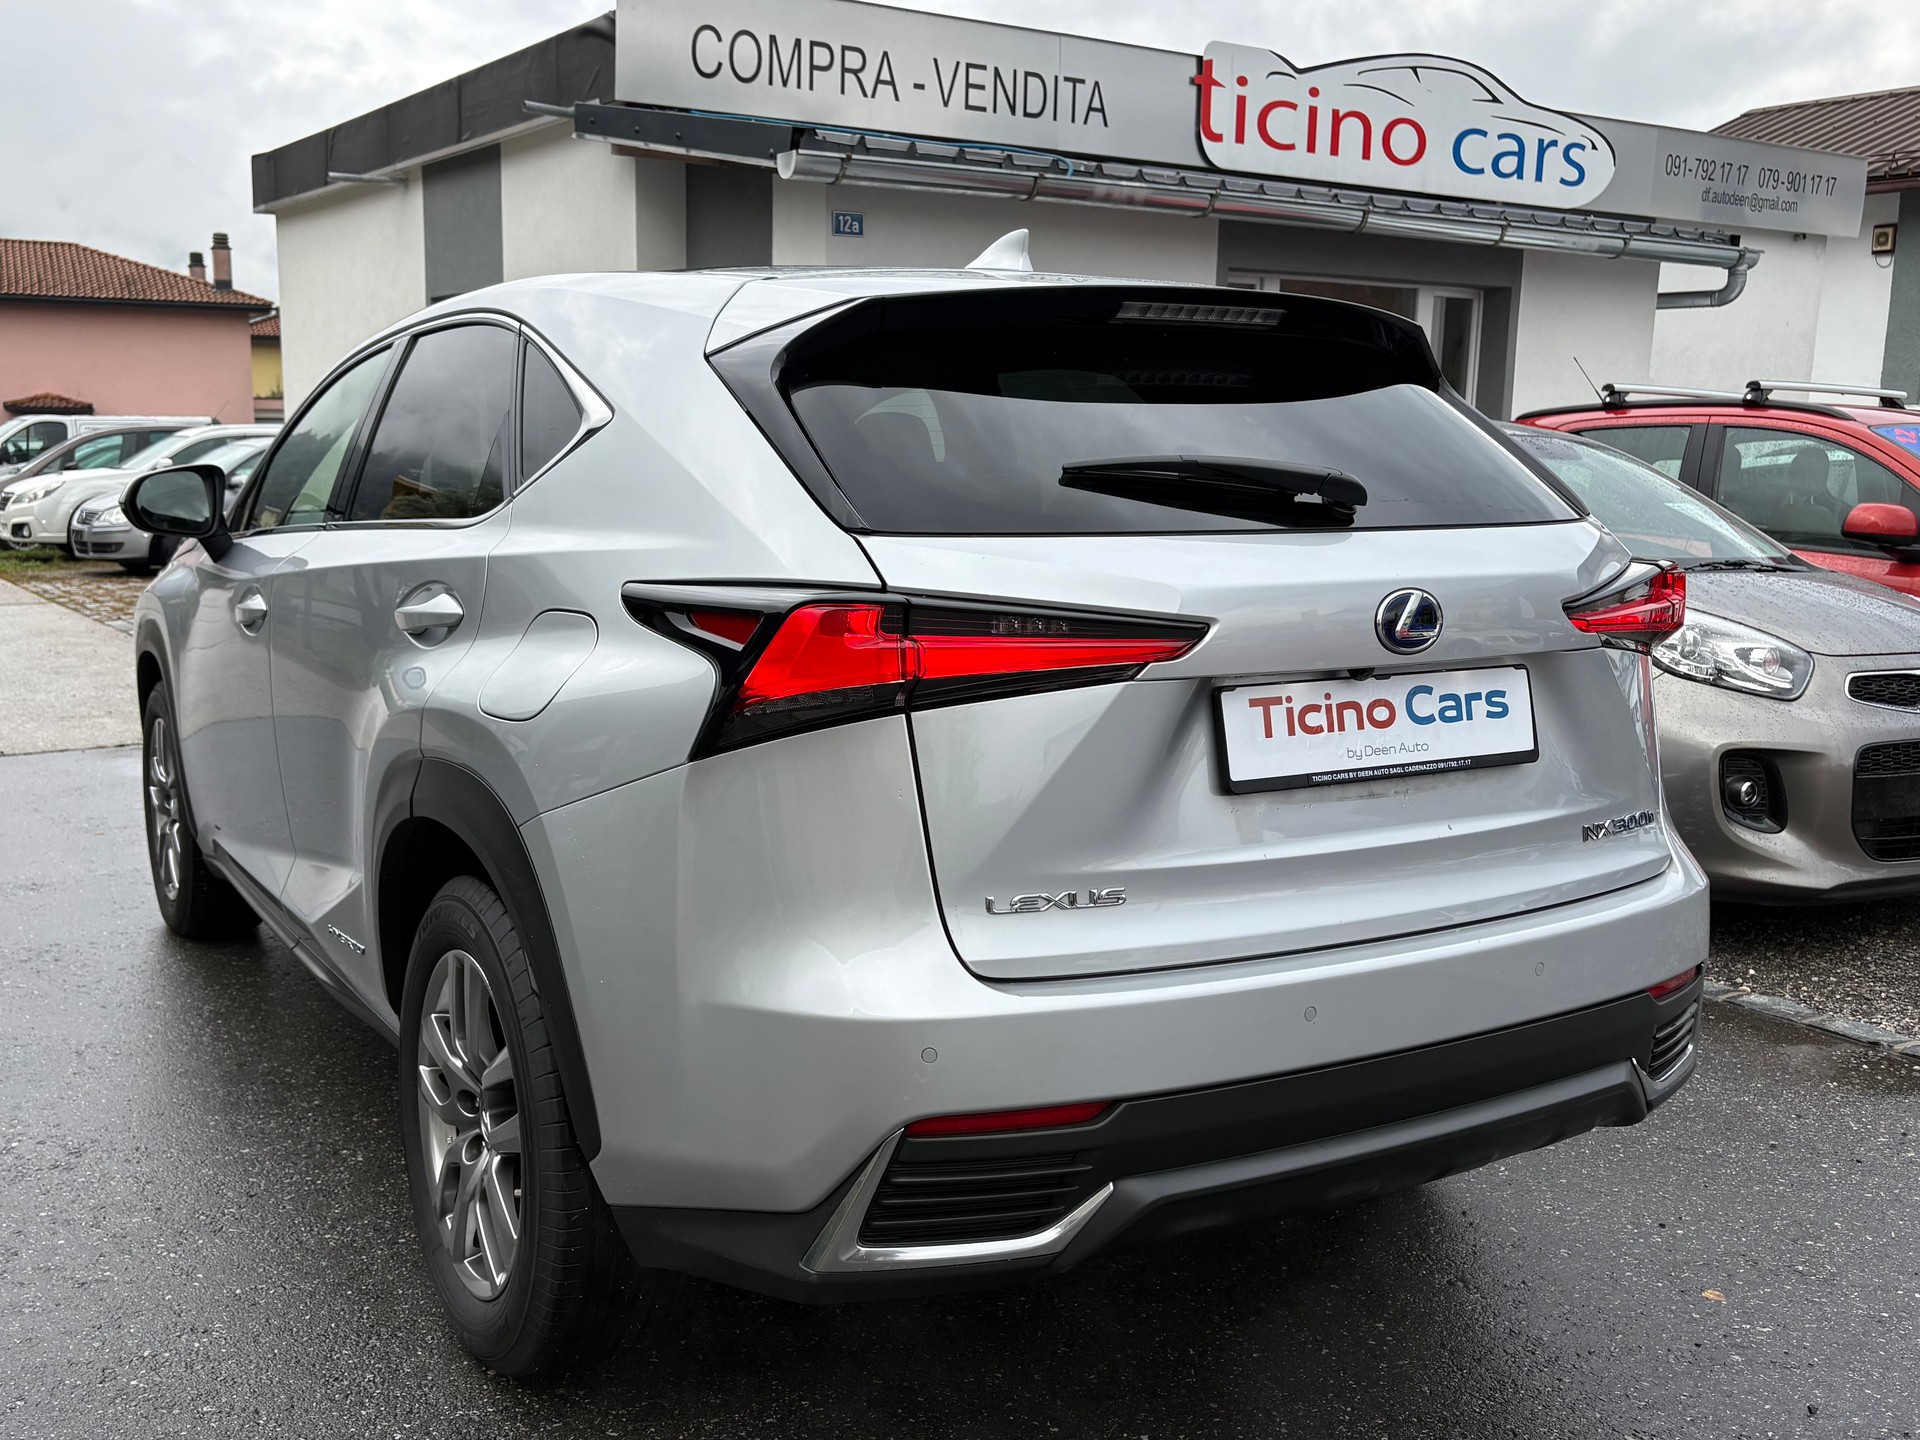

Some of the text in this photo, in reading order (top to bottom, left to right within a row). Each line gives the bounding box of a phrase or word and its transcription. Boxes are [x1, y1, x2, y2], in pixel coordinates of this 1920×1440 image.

[691, 24, 900, 102] COMPRA
[933, 57, 1109, 128] VENDITA
[1194, 58, 1587, 187] ticino cars
[1665, 153, 1837, 197] 091-792 17 17 079-901 17 17
[1701, 186, 1798, 213] df.autodeen@gmail.com
[838, 215, 860, 233] 12a
[1248, 684, 1510, 739] Ticino Cars
[1346, 741, 1430, 761] by Deen Auto
[1312, 774, 1333, 782] TICINO
[1332, 772, 1349, 780] CARS
[1348, 771, 1357, 779] BY
[1357, 769, 1373, 778] DEEN
[1373, 768, 1389, 776] AUTO
[1404, 763, 1437, 773] CADENAZZO
[984, 886, 1127, 915] LEXUS
